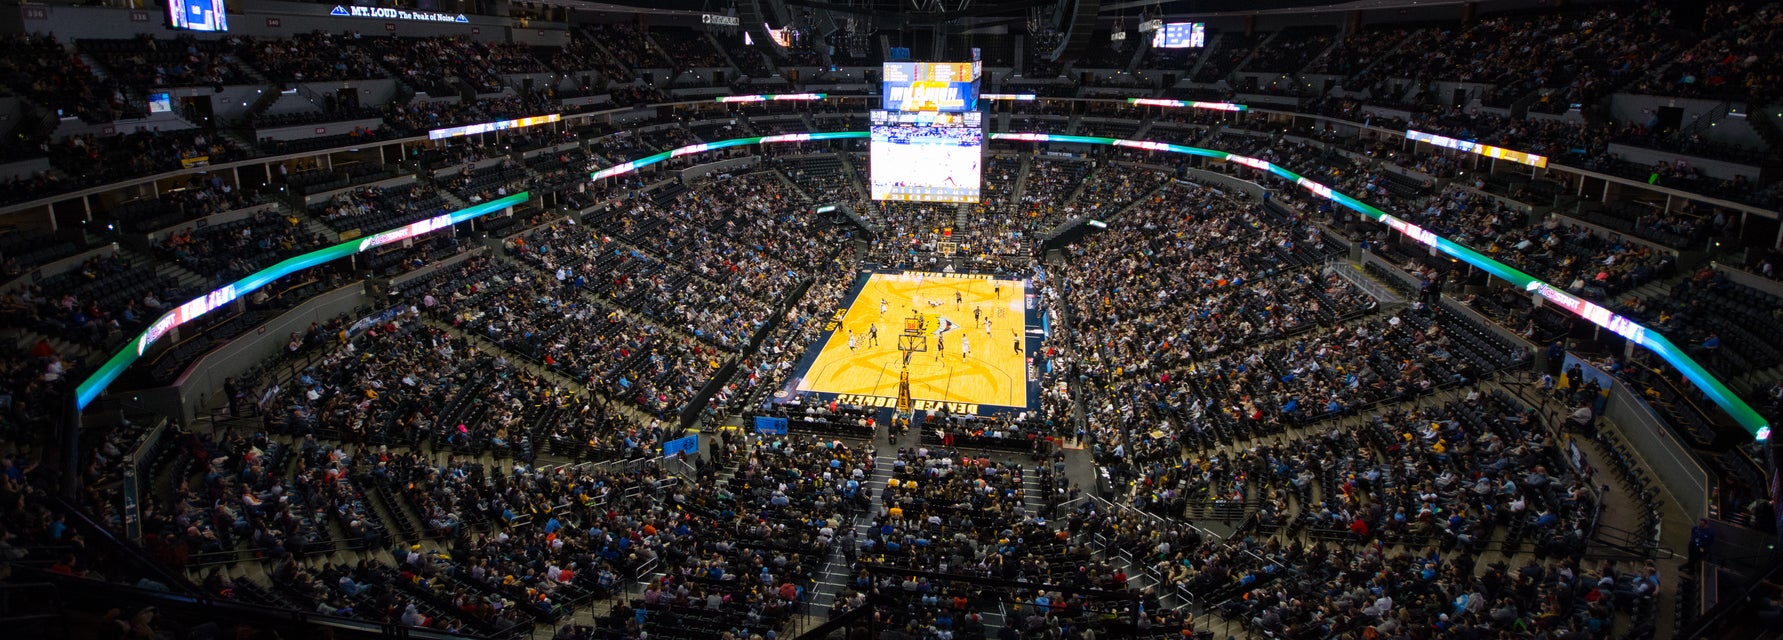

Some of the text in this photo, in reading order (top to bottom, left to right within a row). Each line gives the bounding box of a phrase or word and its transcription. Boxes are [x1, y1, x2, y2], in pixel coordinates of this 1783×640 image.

[350, 6, 455, 22] MT. LOUD The Peak of Noise
